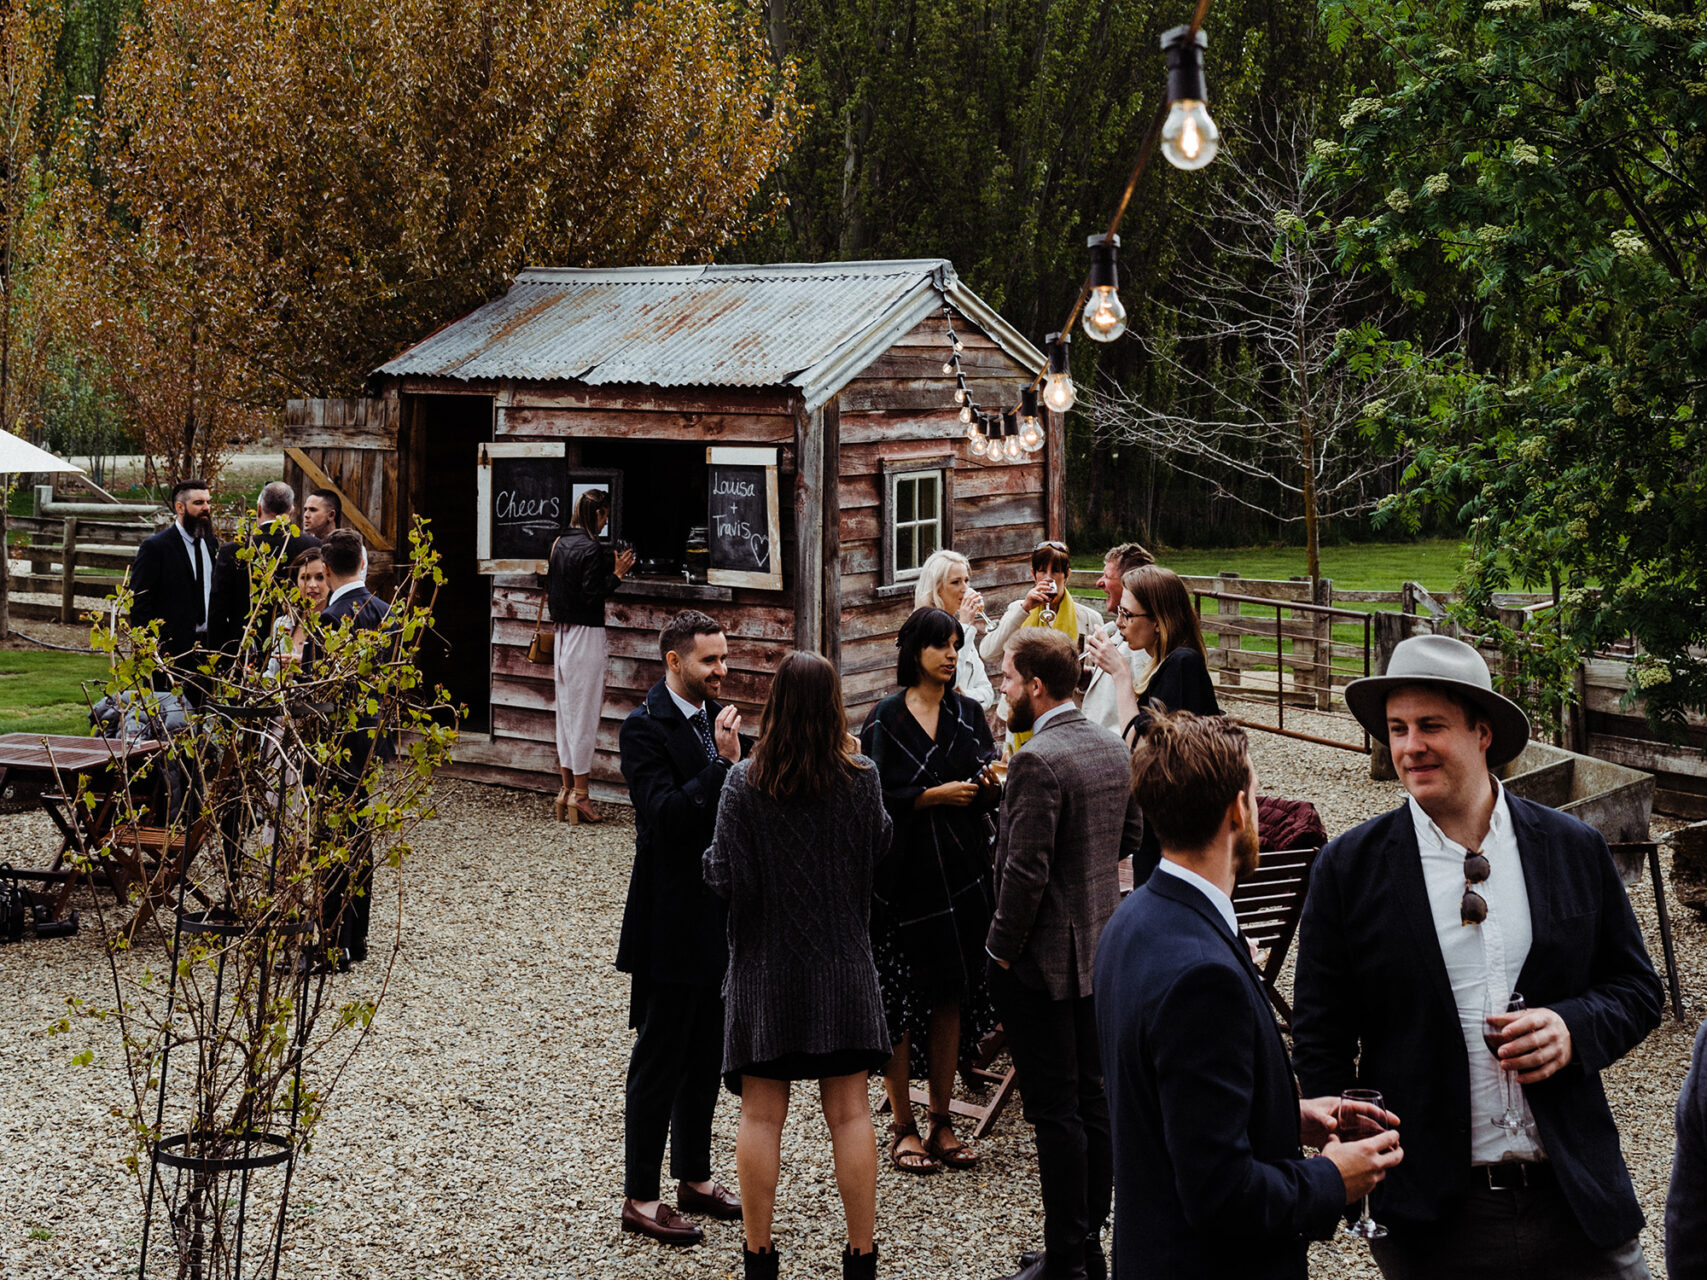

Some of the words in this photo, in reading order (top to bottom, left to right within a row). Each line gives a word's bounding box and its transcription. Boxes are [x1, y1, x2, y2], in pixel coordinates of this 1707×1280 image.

[712, 471, 756, 497] Louisa
[496, 490, 560, 518] Cheers
[712, 514, 751, 540] Travis
